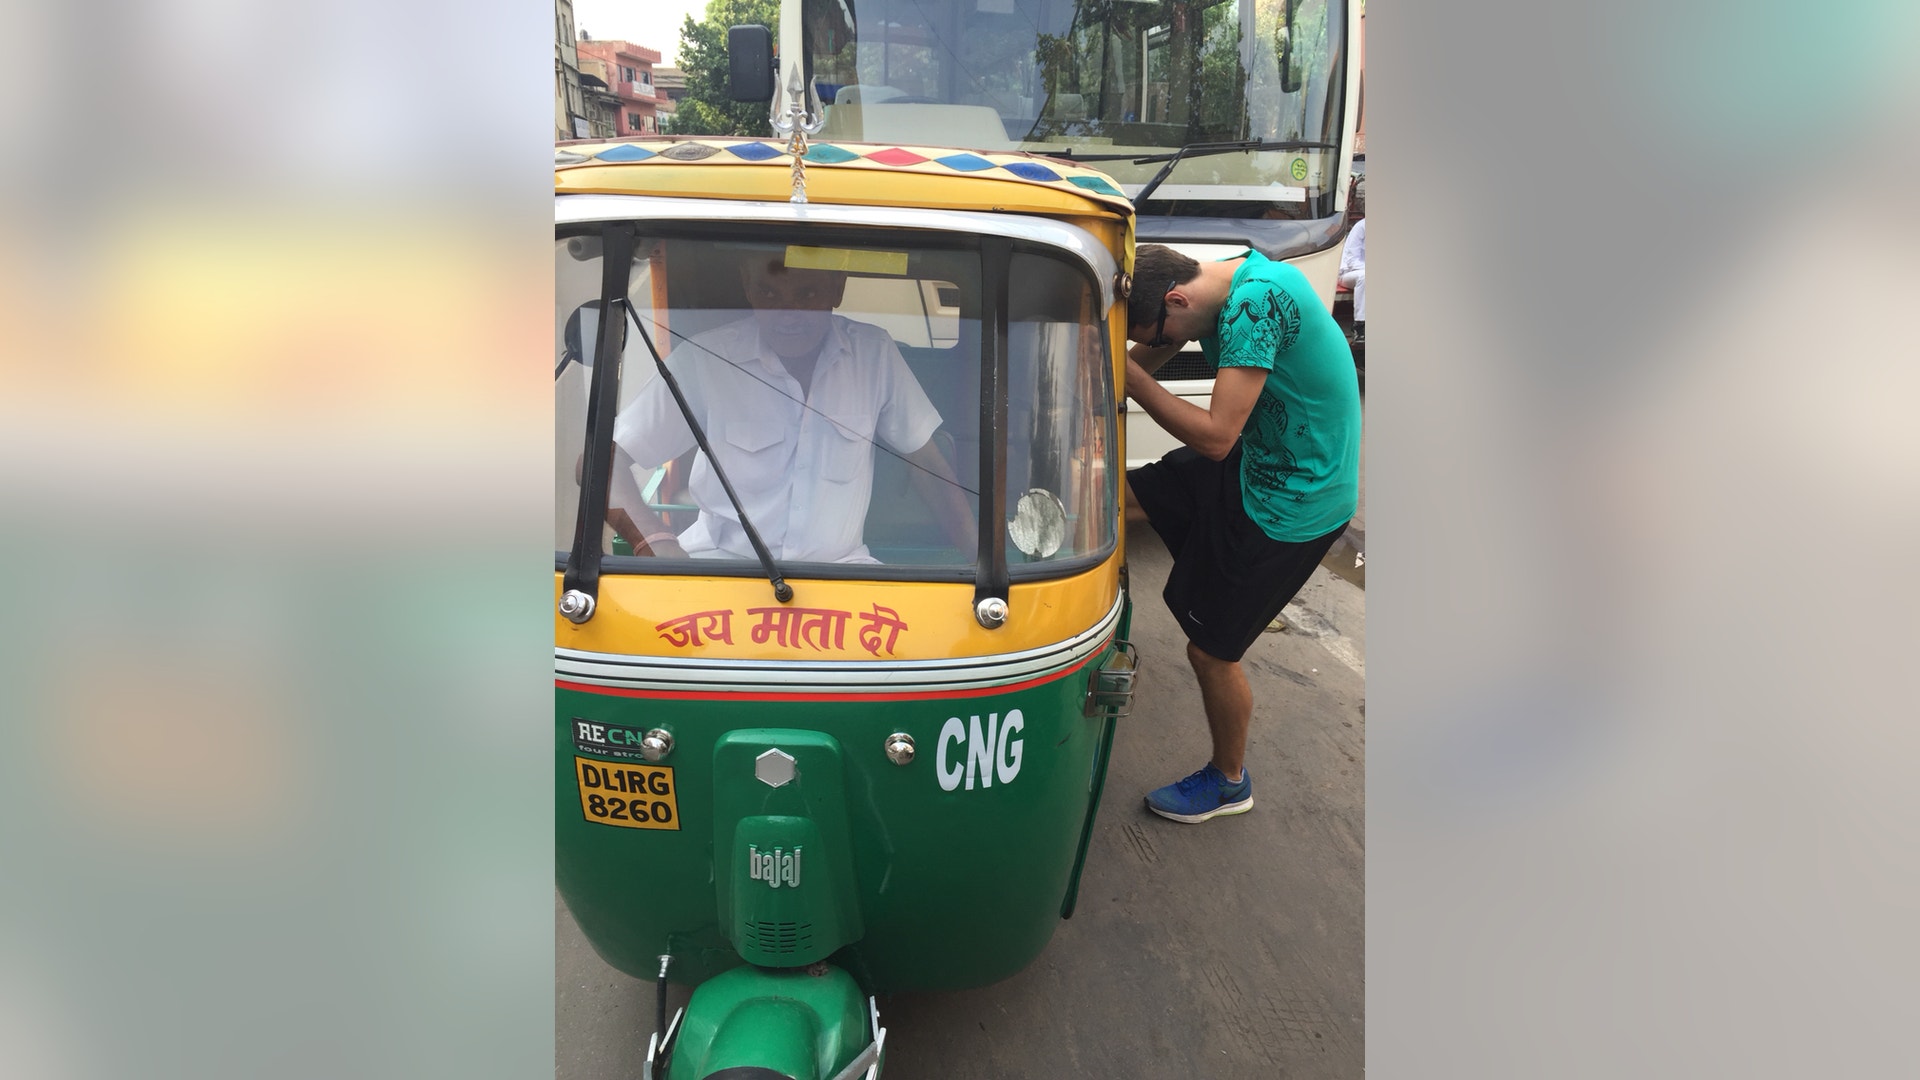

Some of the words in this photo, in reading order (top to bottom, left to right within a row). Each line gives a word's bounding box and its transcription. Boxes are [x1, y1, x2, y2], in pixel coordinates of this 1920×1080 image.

[655, 609, 734, 648] जय
[746, 606, 852, 652] माता
[858, 602, 908, 657] दी
[579, 745, 609, 756] four
[613, 751, 645, 759] stro
[607, 728, 643, 746] CN
[936, 708, 1024, 792] CNG
[582, 763, 670, 796] DL1RG
[588, 793, 672, 823] 8260
[750, 847, 801, 888] bajaj
